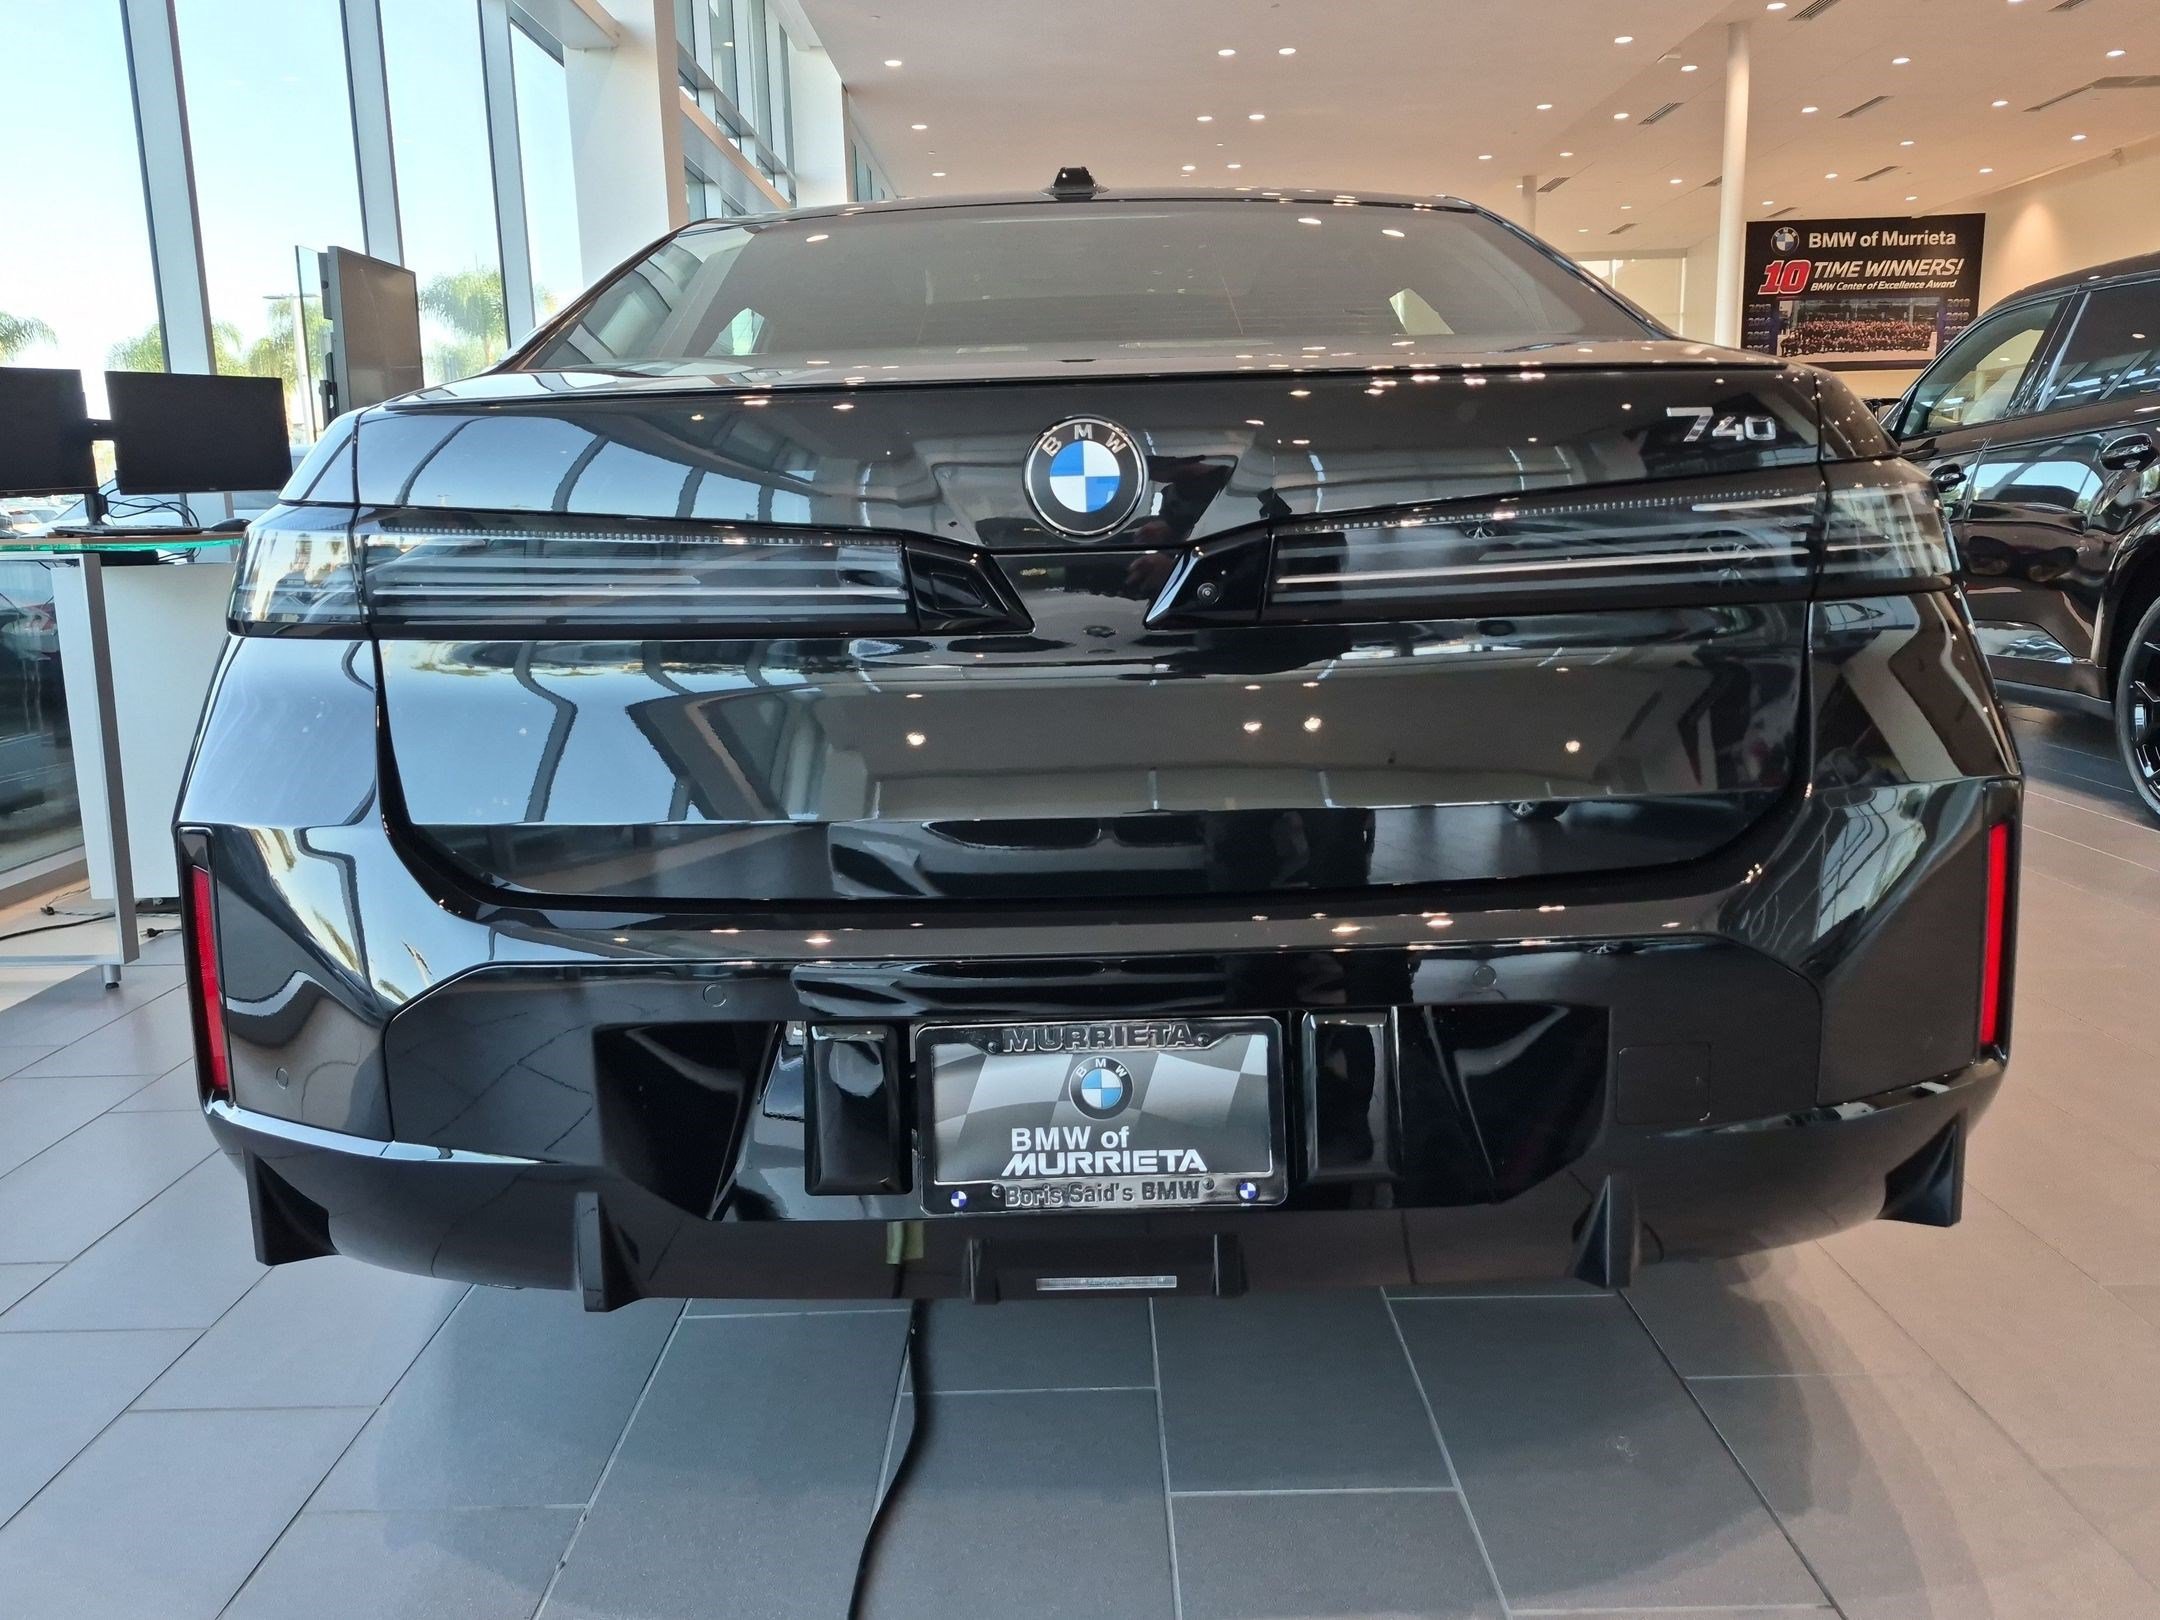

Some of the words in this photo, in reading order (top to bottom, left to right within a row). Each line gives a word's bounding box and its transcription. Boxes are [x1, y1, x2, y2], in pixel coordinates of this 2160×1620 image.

[1809, 231, 1857, 249] BMW
[1860, 230, 1878, 247] of
[1881, 229, 1957, 247] Murrieta
[1758, 259, 1812, 295] 10
[1814, 260, 1864, 278] TIME
[1864, 257, 1965, 277] WINNERS!
[1810, 281, 1836, 292] BMW
[1836, 281, 1867, 291] Center
[1867, 280, 1878, 290] of
[1877, 280, 1925, 290] Excellence
[1925, 279, 1957, 289] Award
[1666, 406, 1777, 442] 740
[1041, 423, 1127, 457] BMW
[1002, 1024, 1196, 1053] MURRIETA
[1075, 1058, 1127, 1078] BMW
[1011, 1126, 1090, 1151] BMW
[1101, 1126, 1130, 1149] of
[1001, 1148, 1208, 1176] MURRIETA
[1005, 1184, 1065, 1208] Boris
[1068, 1183, 1133, 1203] Said's
[1141, 1180, 1201, 1201] BMW
